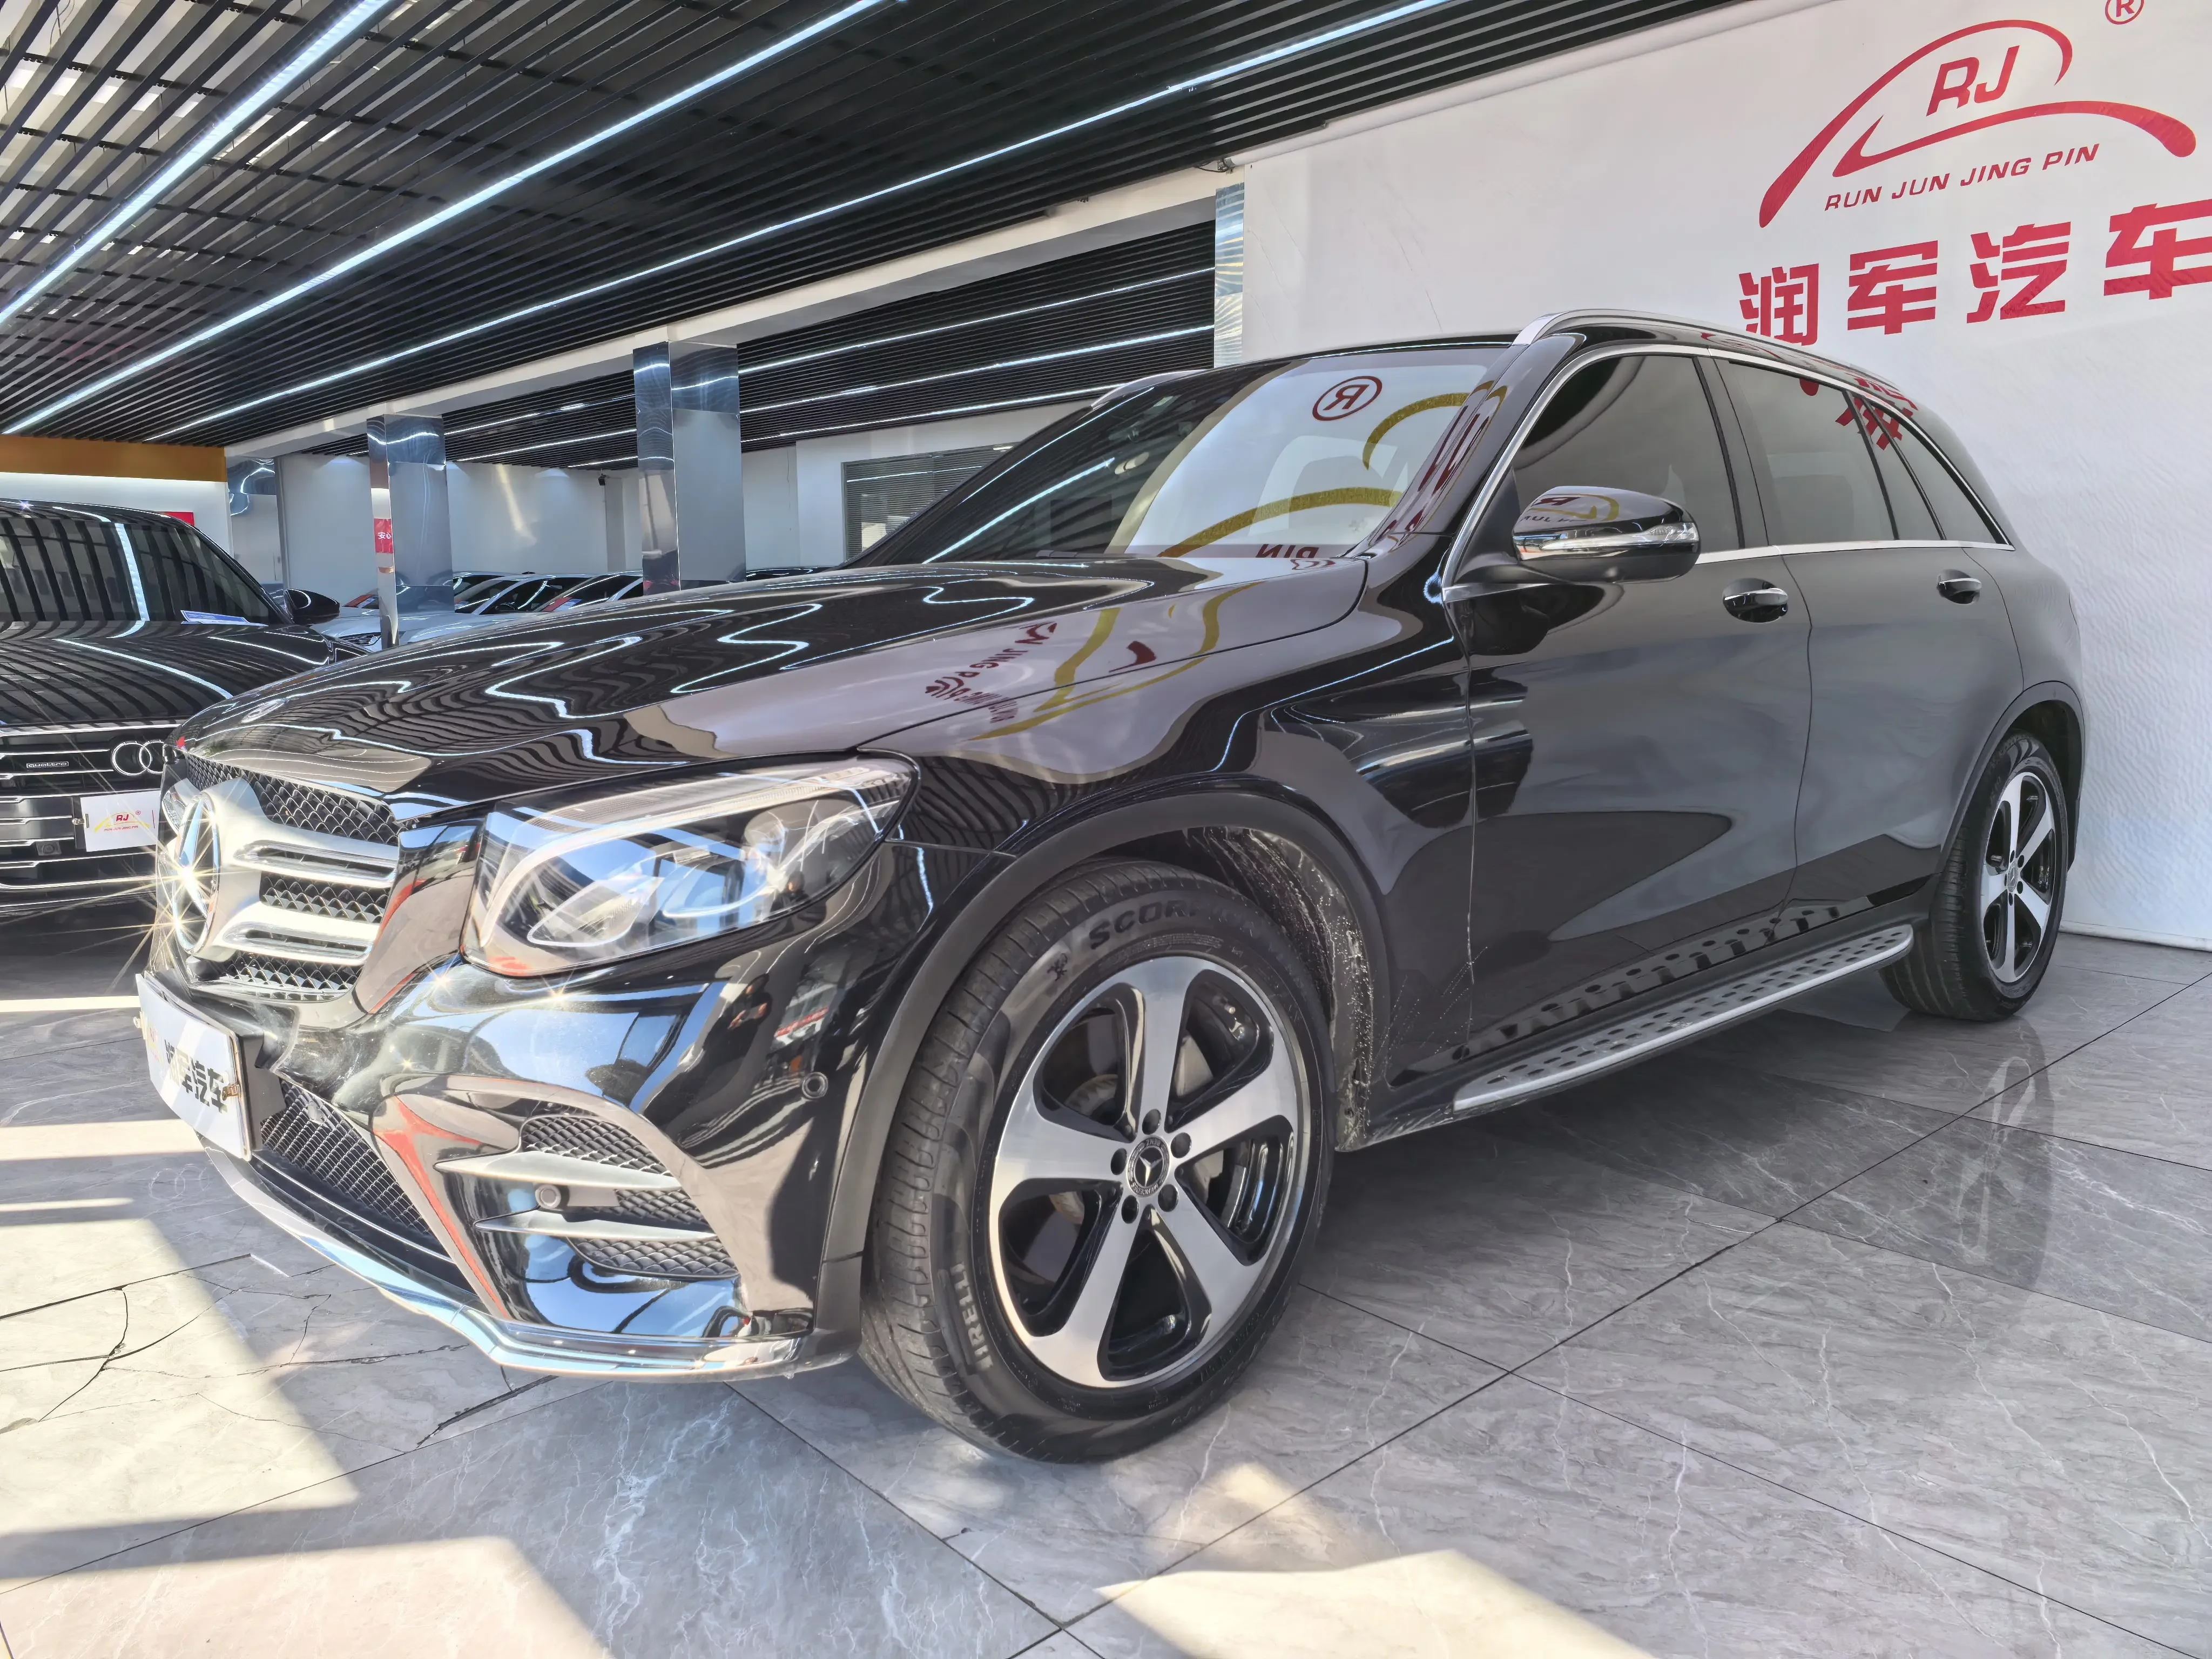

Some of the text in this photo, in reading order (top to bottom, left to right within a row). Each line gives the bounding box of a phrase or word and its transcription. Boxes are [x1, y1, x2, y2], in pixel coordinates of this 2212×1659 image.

[1926, 45, 2020, 117] RJ
[1824, 143, 2100, 211] RUN JUN JING PIN
[1738, 198, 2212, 346] 润军汽车
